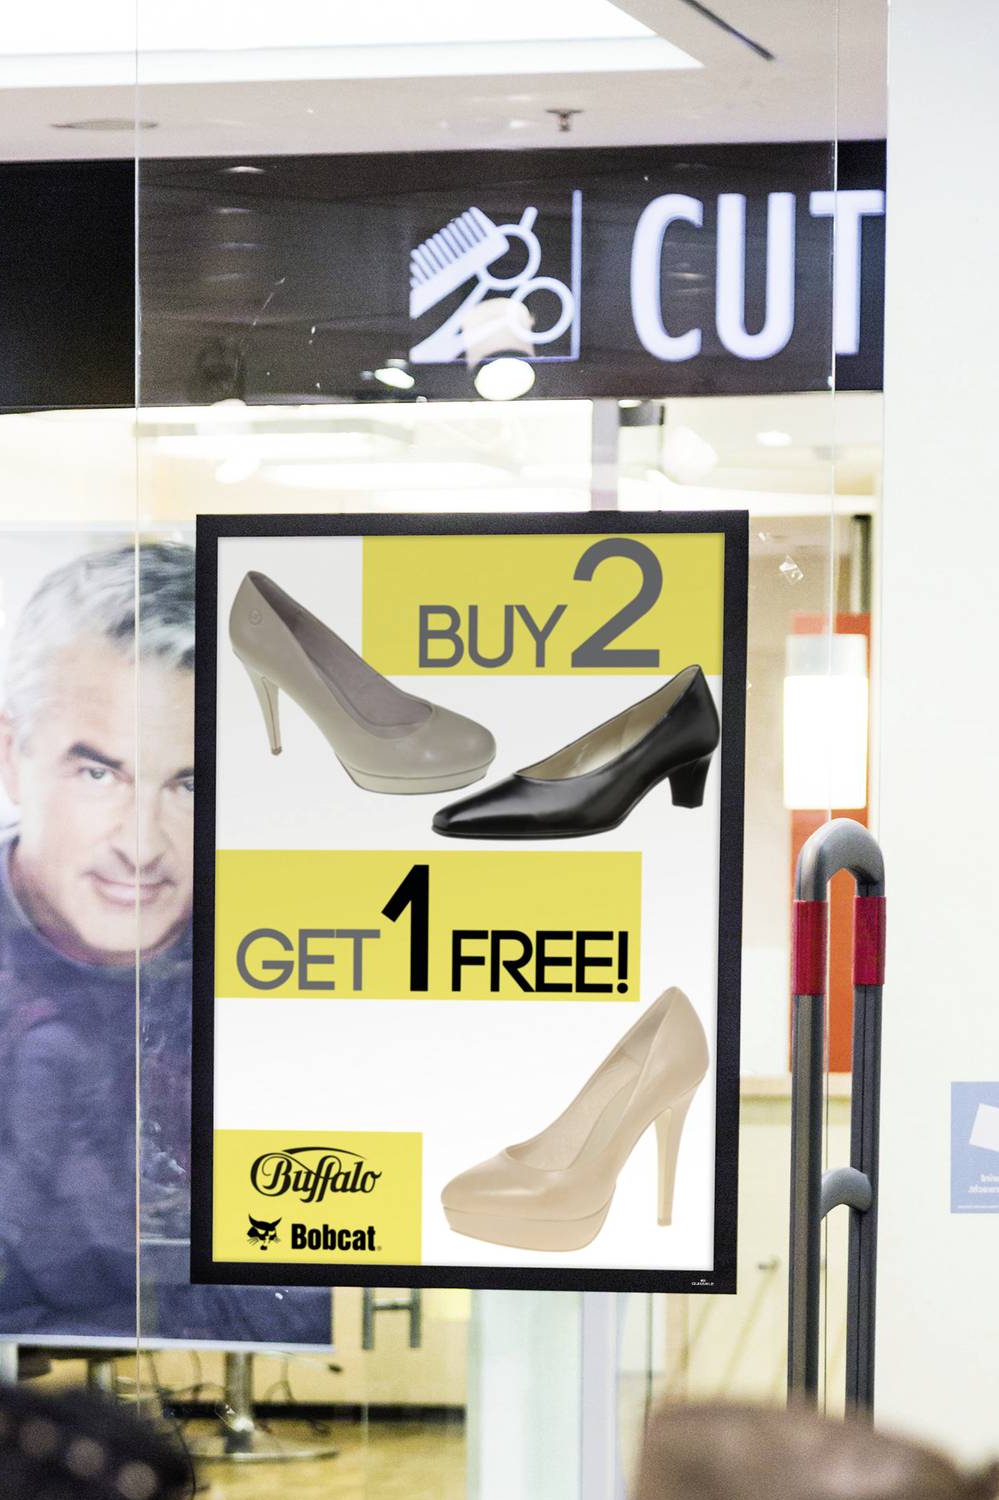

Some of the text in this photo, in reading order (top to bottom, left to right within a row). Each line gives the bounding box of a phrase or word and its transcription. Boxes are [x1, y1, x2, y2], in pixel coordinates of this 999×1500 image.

[630, 190, 885, 361] CUT
[418, 537, 664, 668] BUY 2
[236, 864, 629, 994] GET 1 FREE!
[250, 1146, 382, 1203] Buffalo
[291, 1223, 376, 1251] Bobcat
